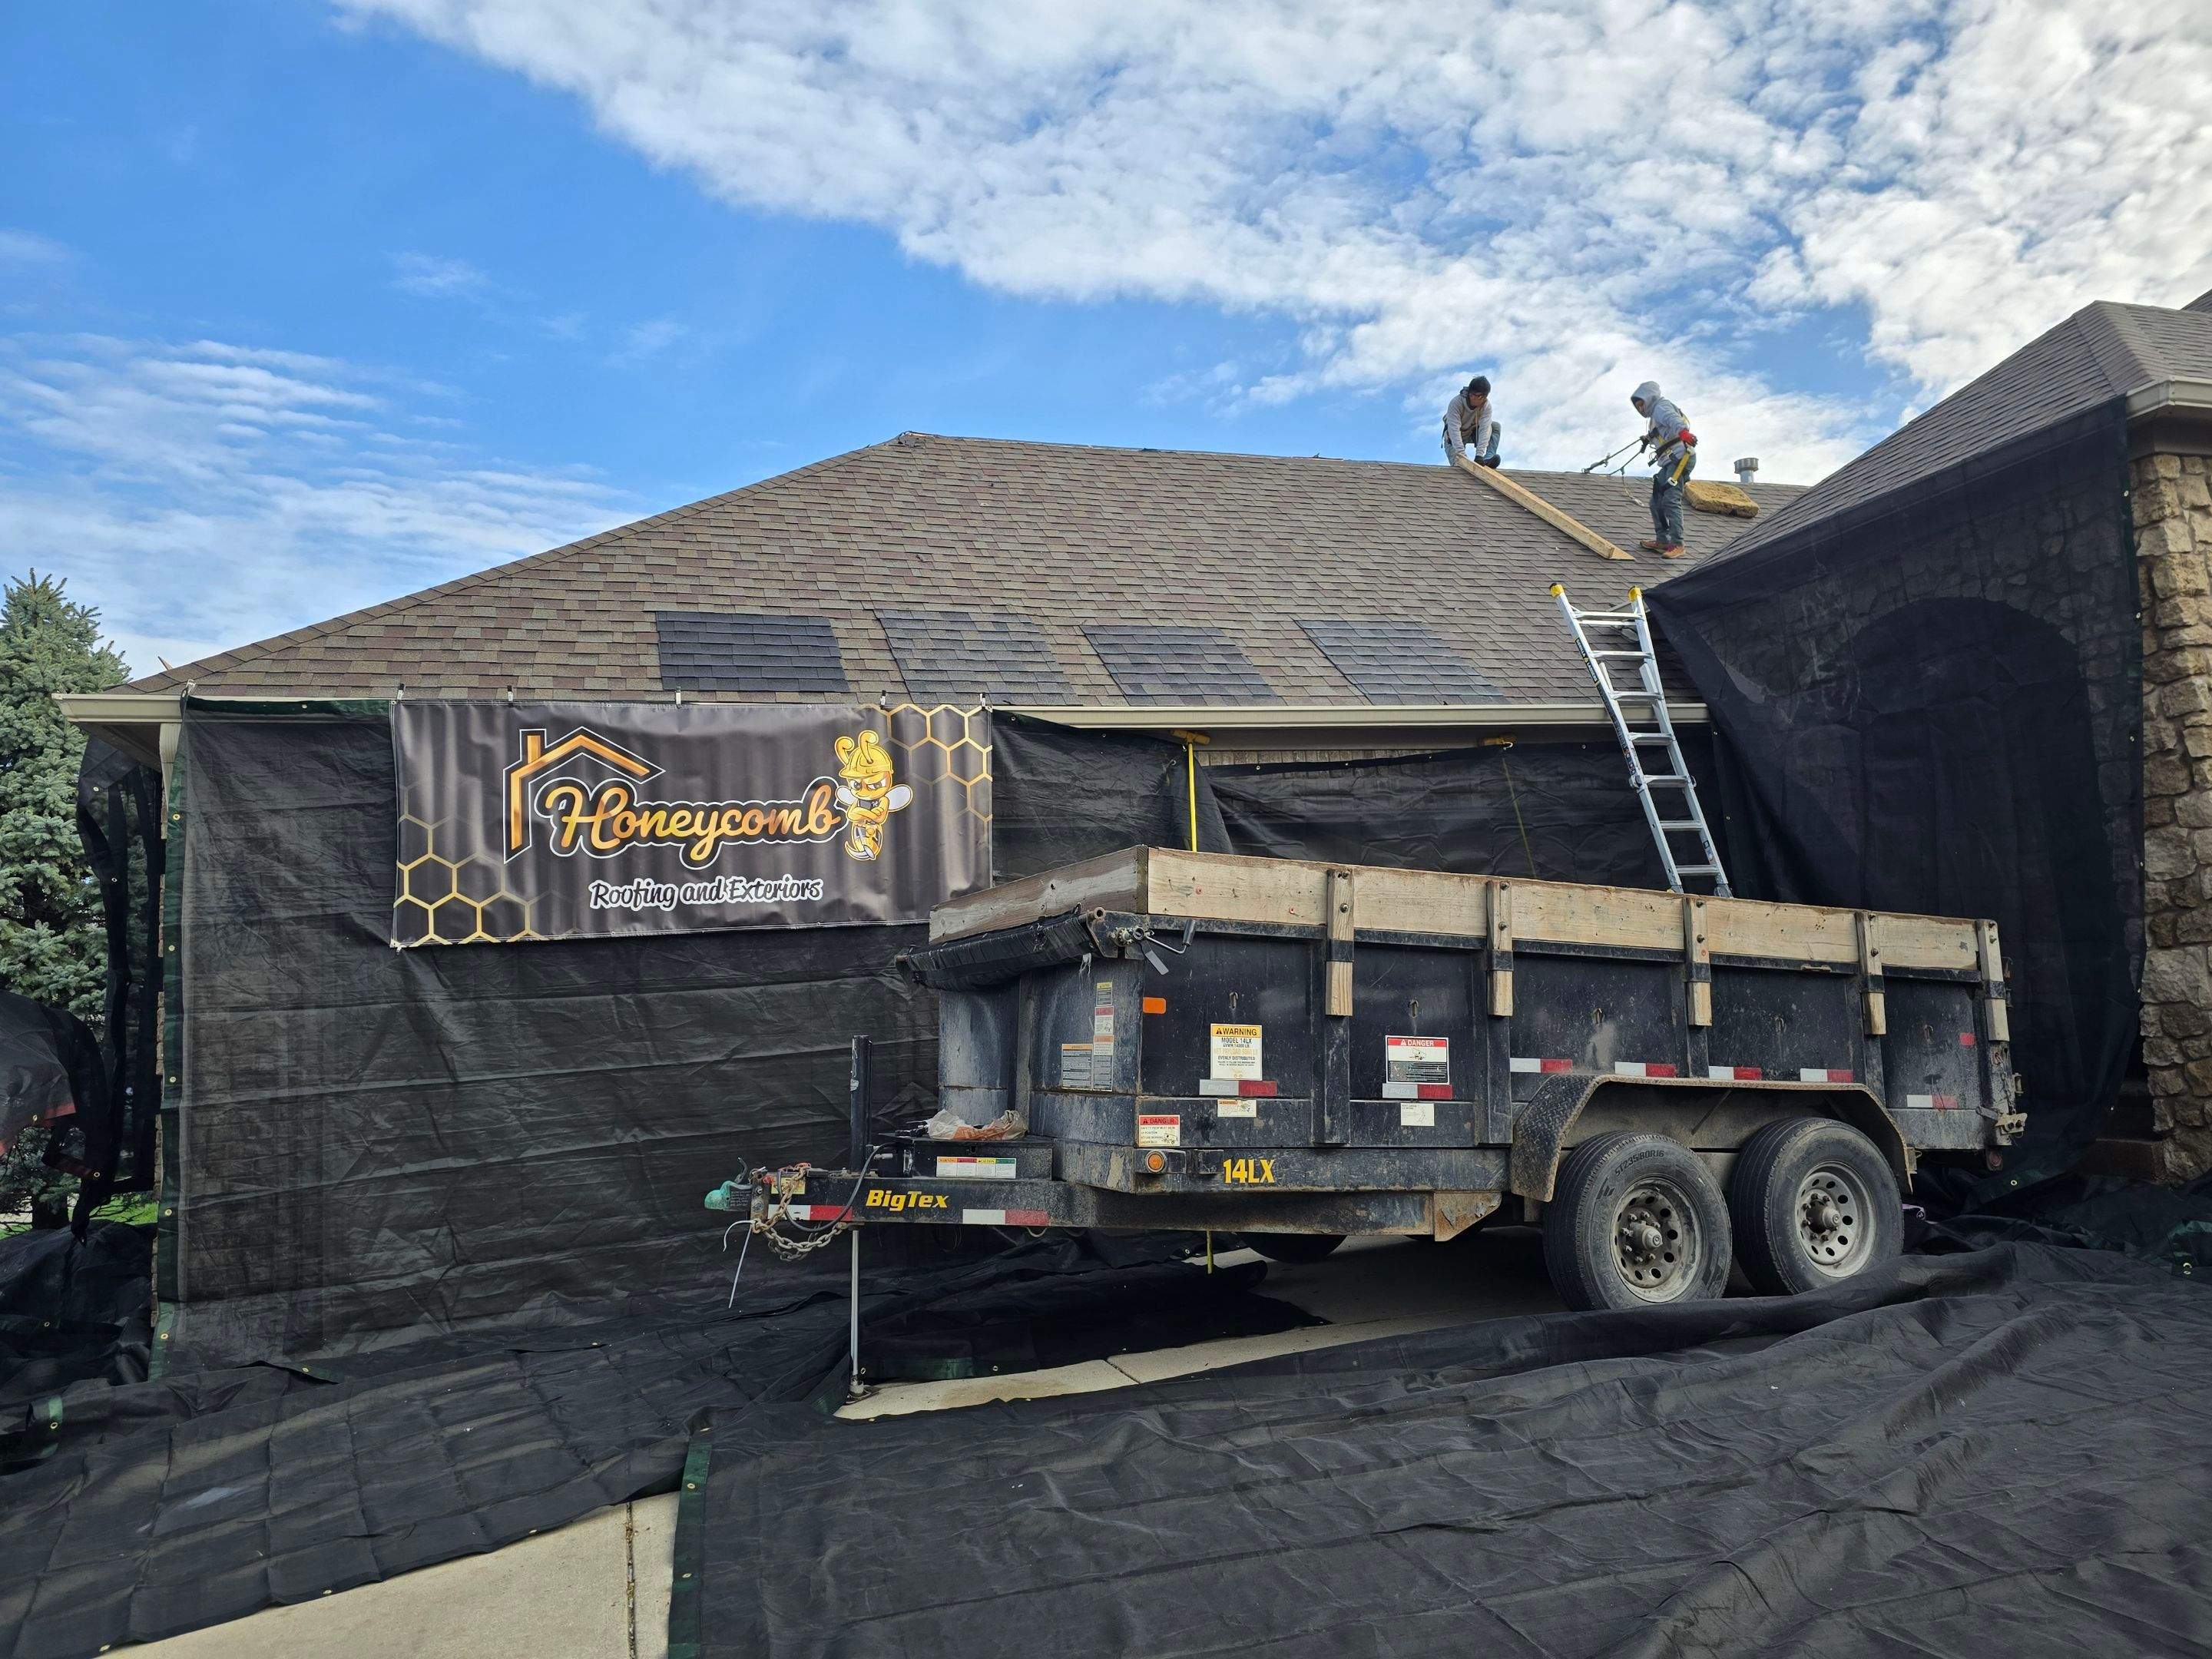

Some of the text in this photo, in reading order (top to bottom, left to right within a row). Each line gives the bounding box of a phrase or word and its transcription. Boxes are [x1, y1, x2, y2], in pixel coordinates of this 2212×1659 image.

[545, 784, 841, 861] Honeycomb
[590, 876, 821, 909] Roofing and Exteriors
[1223, 1158, 1275, 1184] 14LX
[866, 1190, 949, 1212] BigTex
